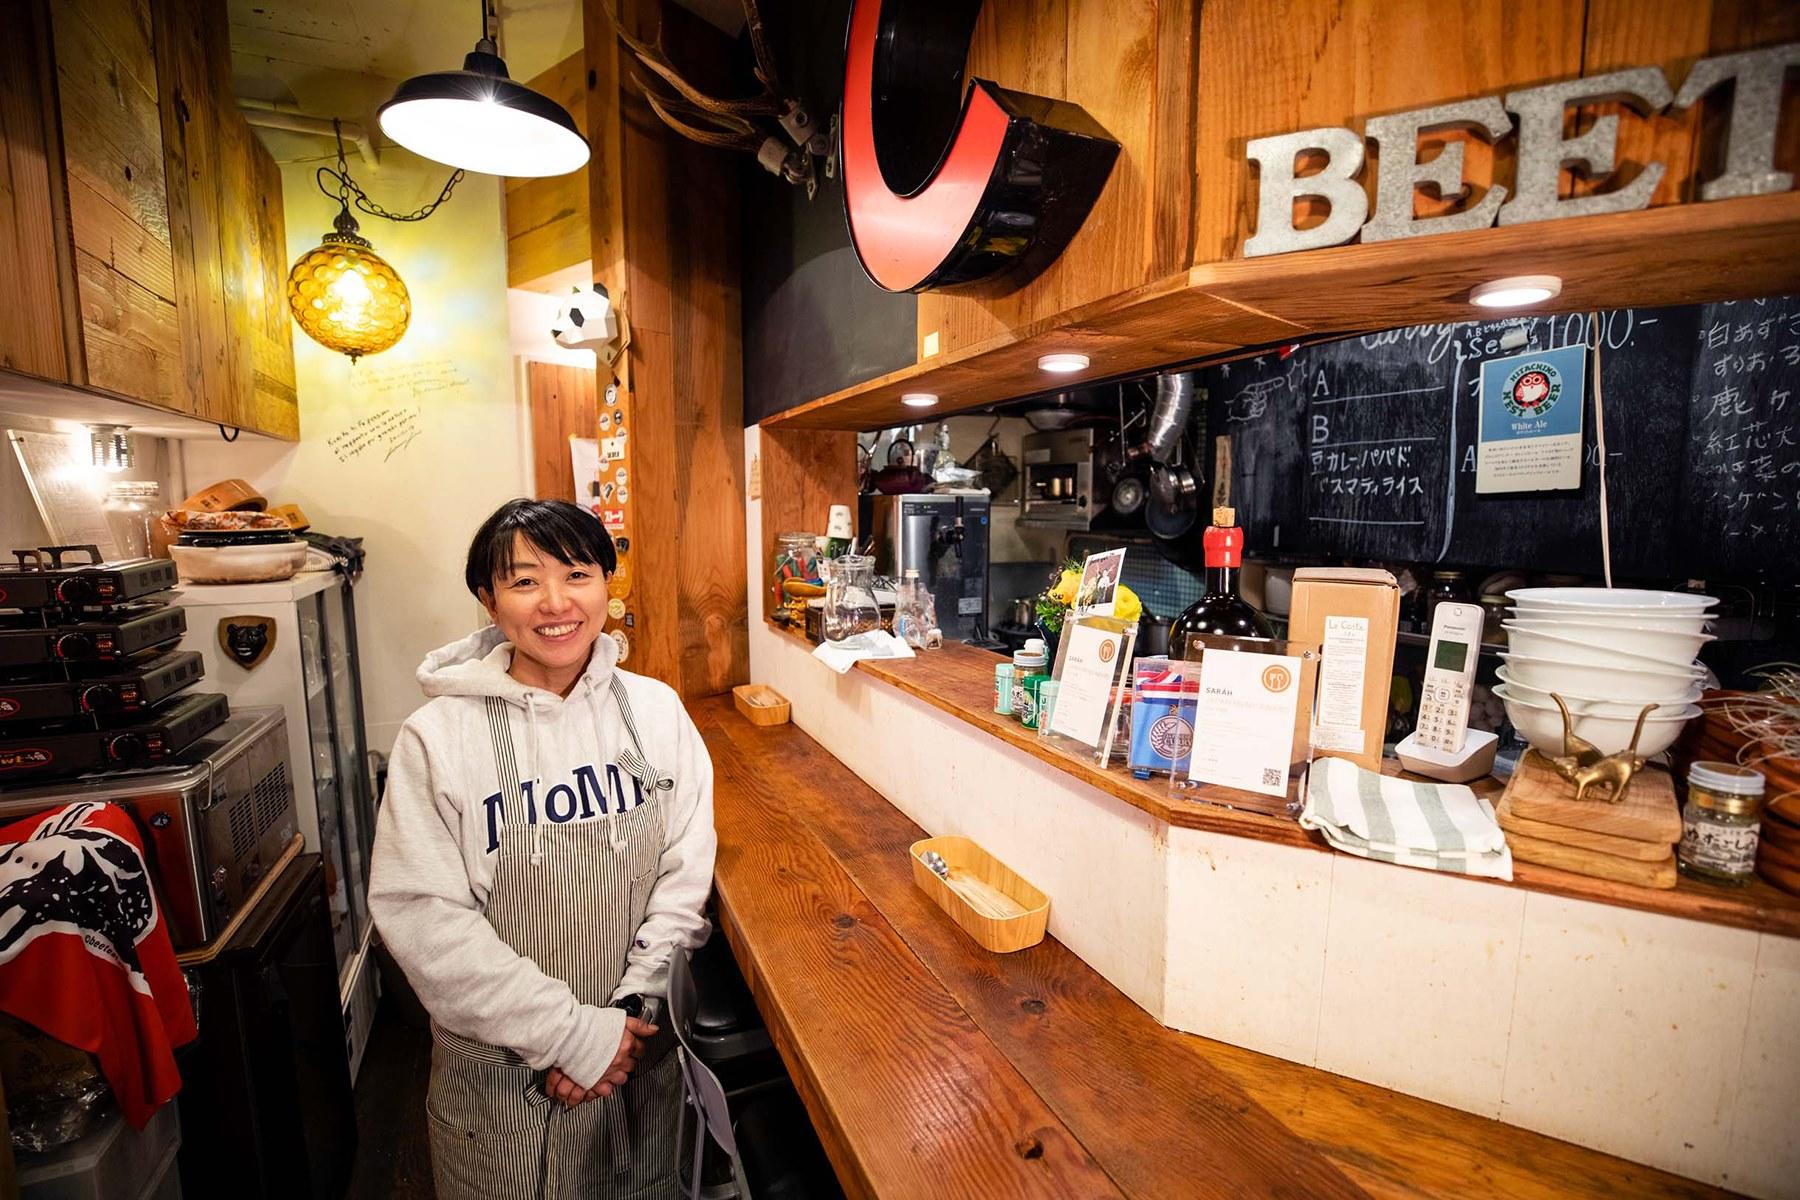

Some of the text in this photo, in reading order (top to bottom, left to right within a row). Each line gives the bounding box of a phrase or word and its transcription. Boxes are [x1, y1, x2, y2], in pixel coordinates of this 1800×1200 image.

[1244, 42, 1800, 258] BEET
[1312, 369, 1329, 397] A
[1510, 362, 1557, 383] HITACHINO
[1503, 382, 1562, 418] NEST BEER
[1311, 415, 1329, 444] B
[1511, 419, 1548, 431] White Ale
[483, 763, 647, 855] MoM
